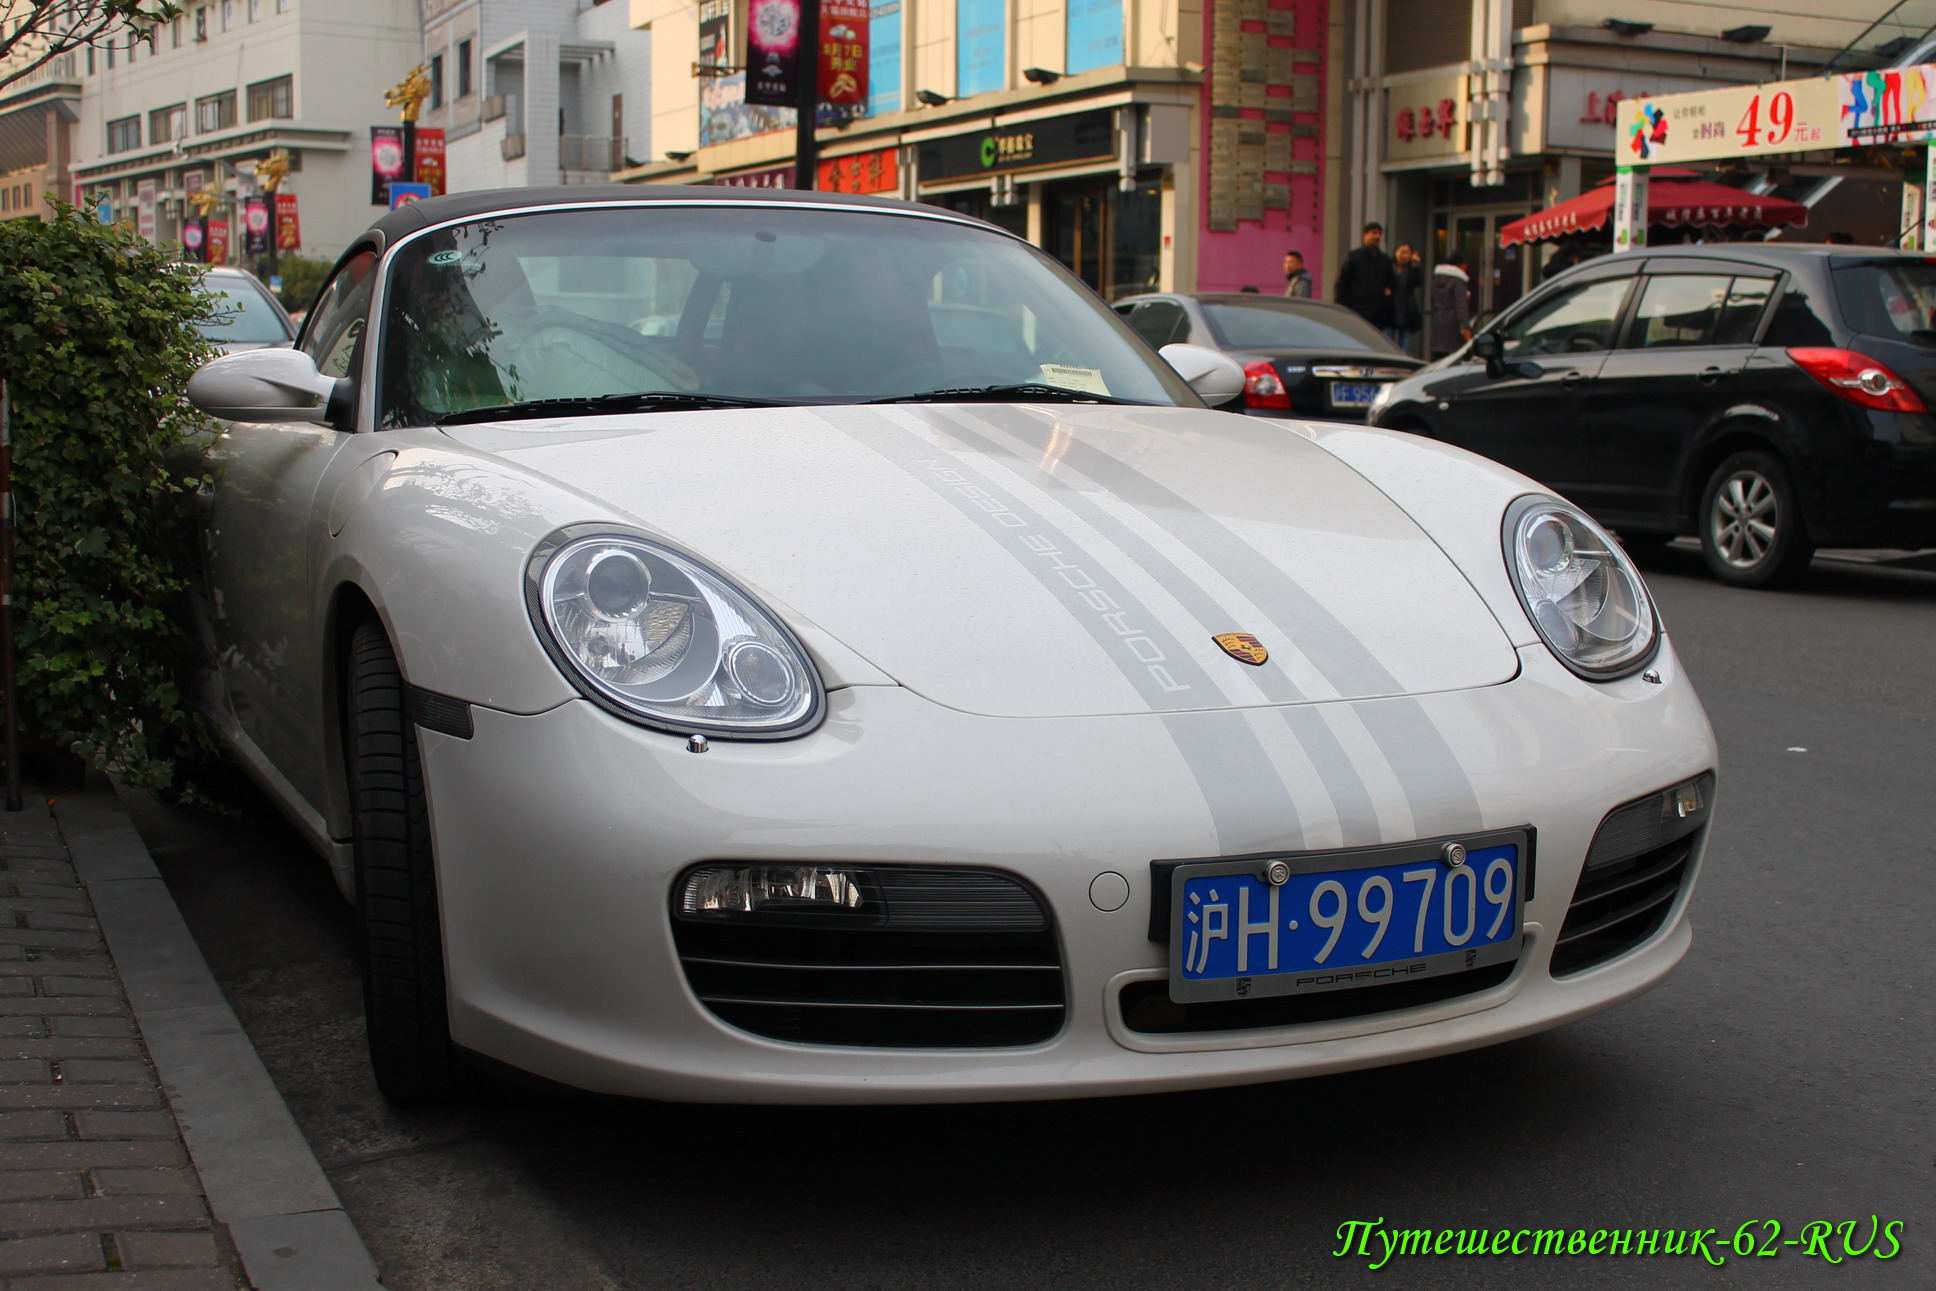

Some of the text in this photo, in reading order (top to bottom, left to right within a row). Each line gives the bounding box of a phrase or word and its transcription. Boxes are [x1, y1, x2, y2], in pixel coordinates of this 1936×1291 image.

[823, 43, 863, 58] 9月7日
[830, 57, 858, 72] 开业
[434, 251, 455, 262] CCC
[917, 458, 1193, 692] PORSCHE DESIGN
[1296, 962, 1427, 987] PORSCHE
